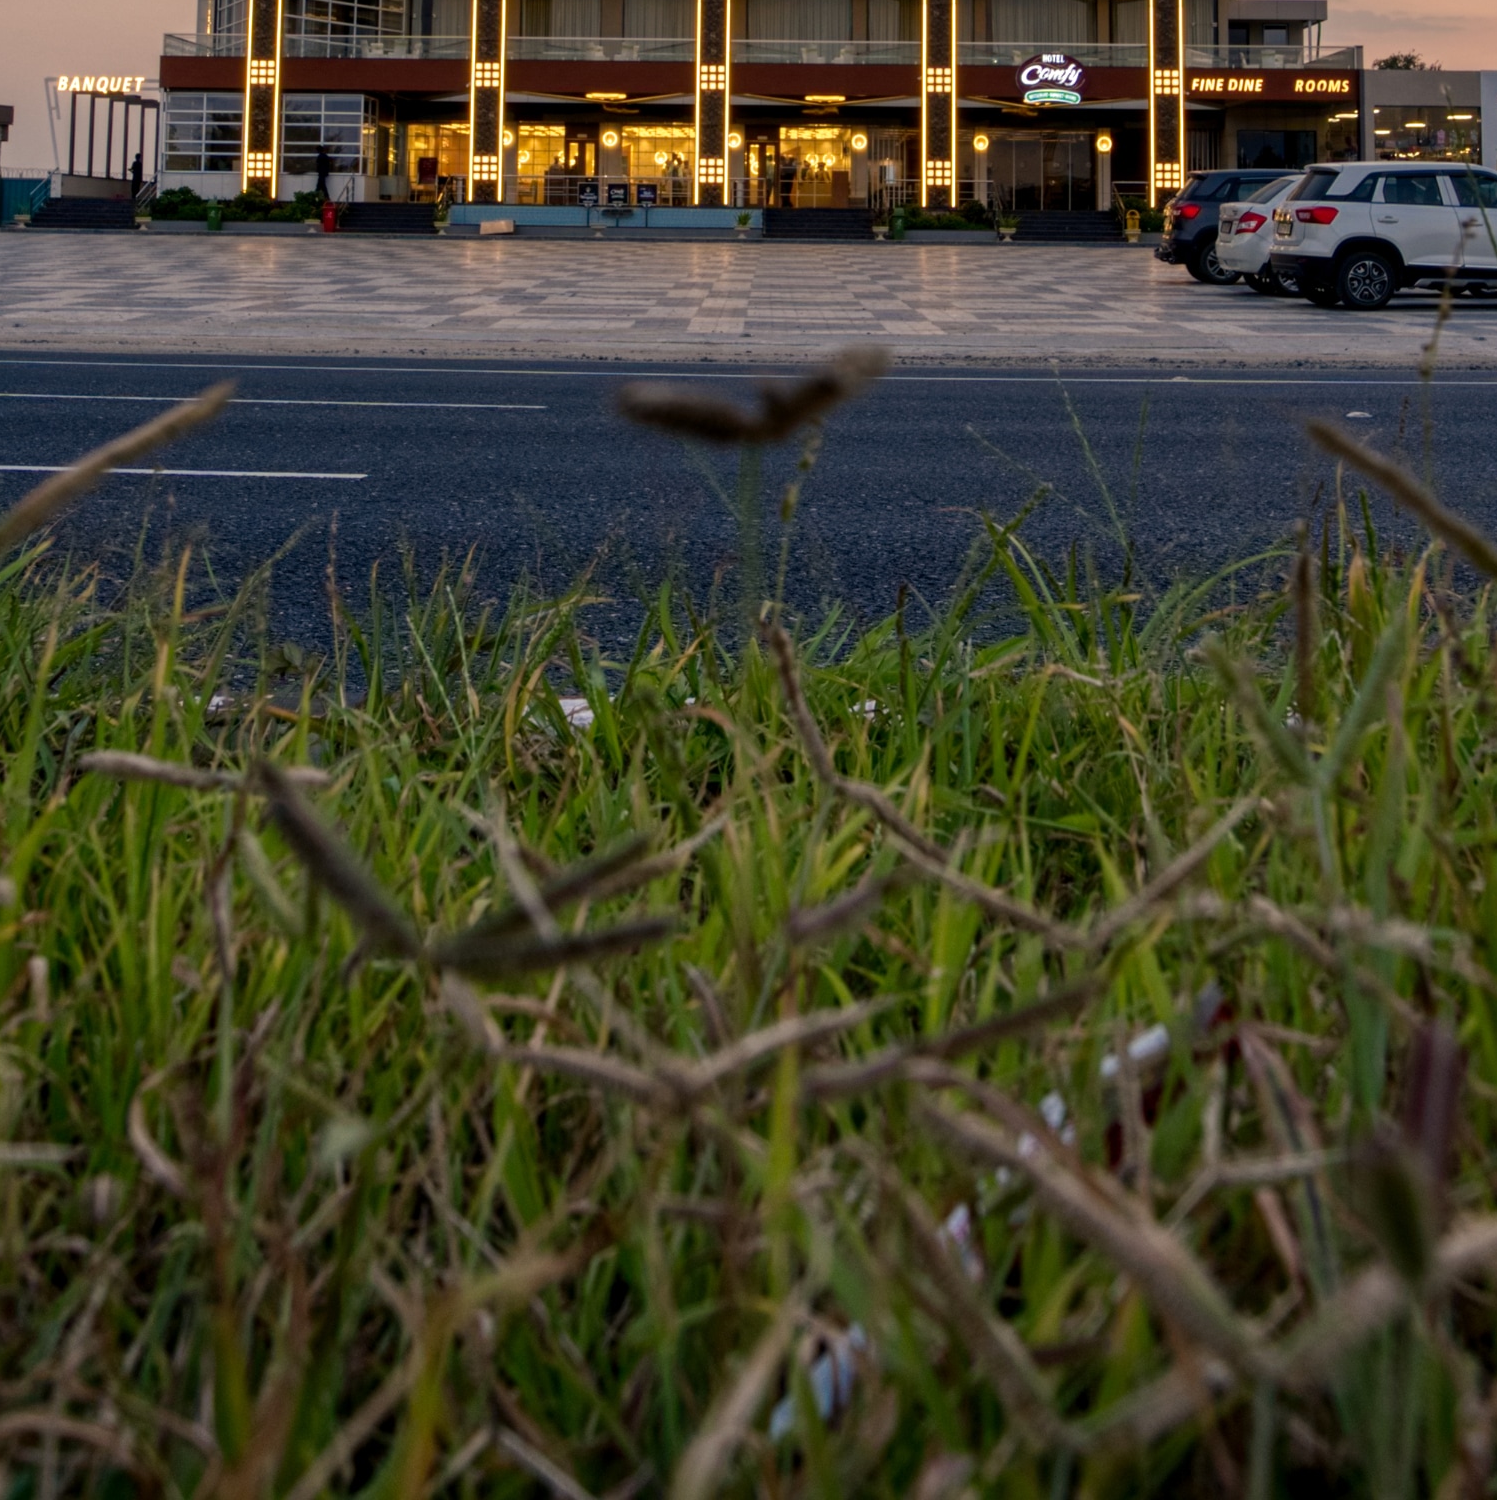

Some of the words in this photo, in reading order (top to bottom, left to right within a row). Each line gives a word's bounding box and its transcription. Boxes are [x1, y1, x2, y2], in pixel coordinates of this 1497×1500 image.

[1042, 54, 1065, 63] HOTEL
[1021, 63, 1082, 86] Comfy
[57, 76, 145, 94] BANQUET
[1191, 78, 1224, 91] FINE
[1227, 78, 1263, 92] DINE
[1294, 79, 1350, 93] ROOMS
